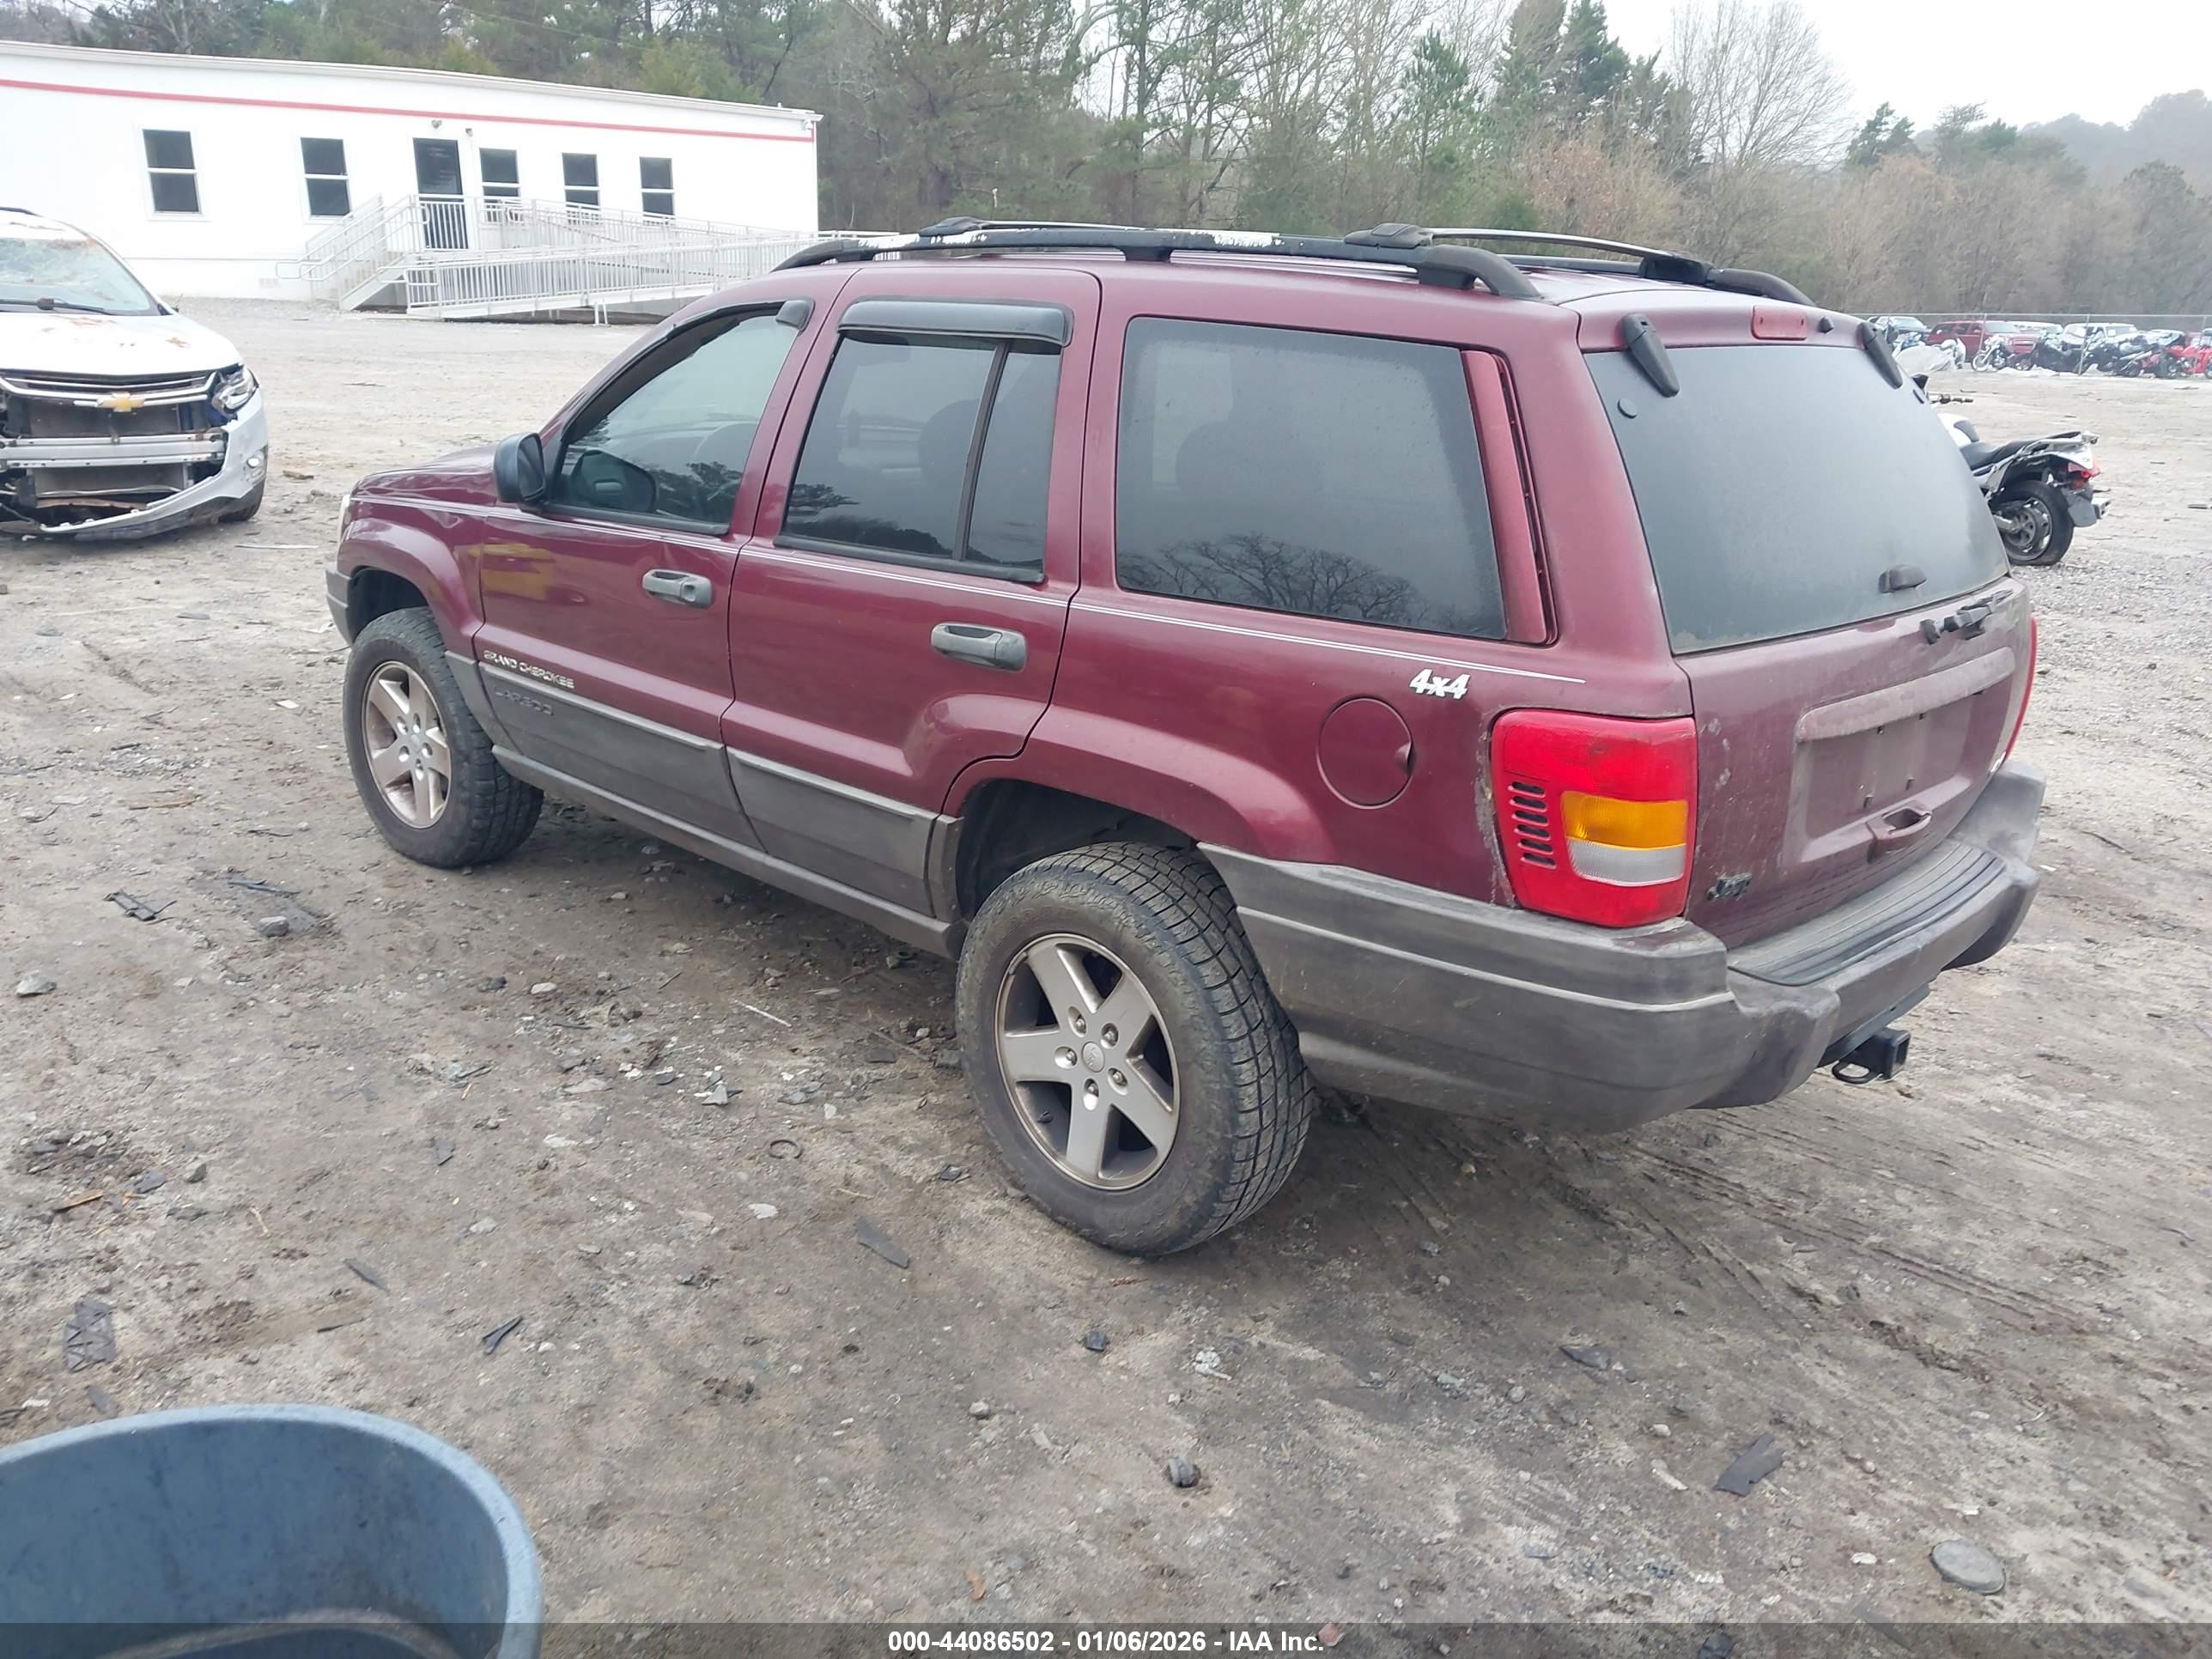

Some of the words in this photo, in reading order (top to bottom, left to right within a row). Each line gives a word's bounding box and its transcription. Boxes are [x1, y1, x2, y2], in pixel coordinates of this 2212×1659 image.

[483, 649, 518, 669] GRAND
[519, 661, 574, 689] CHEROKEE
[1408, 668, 1471, 700] 4x4
